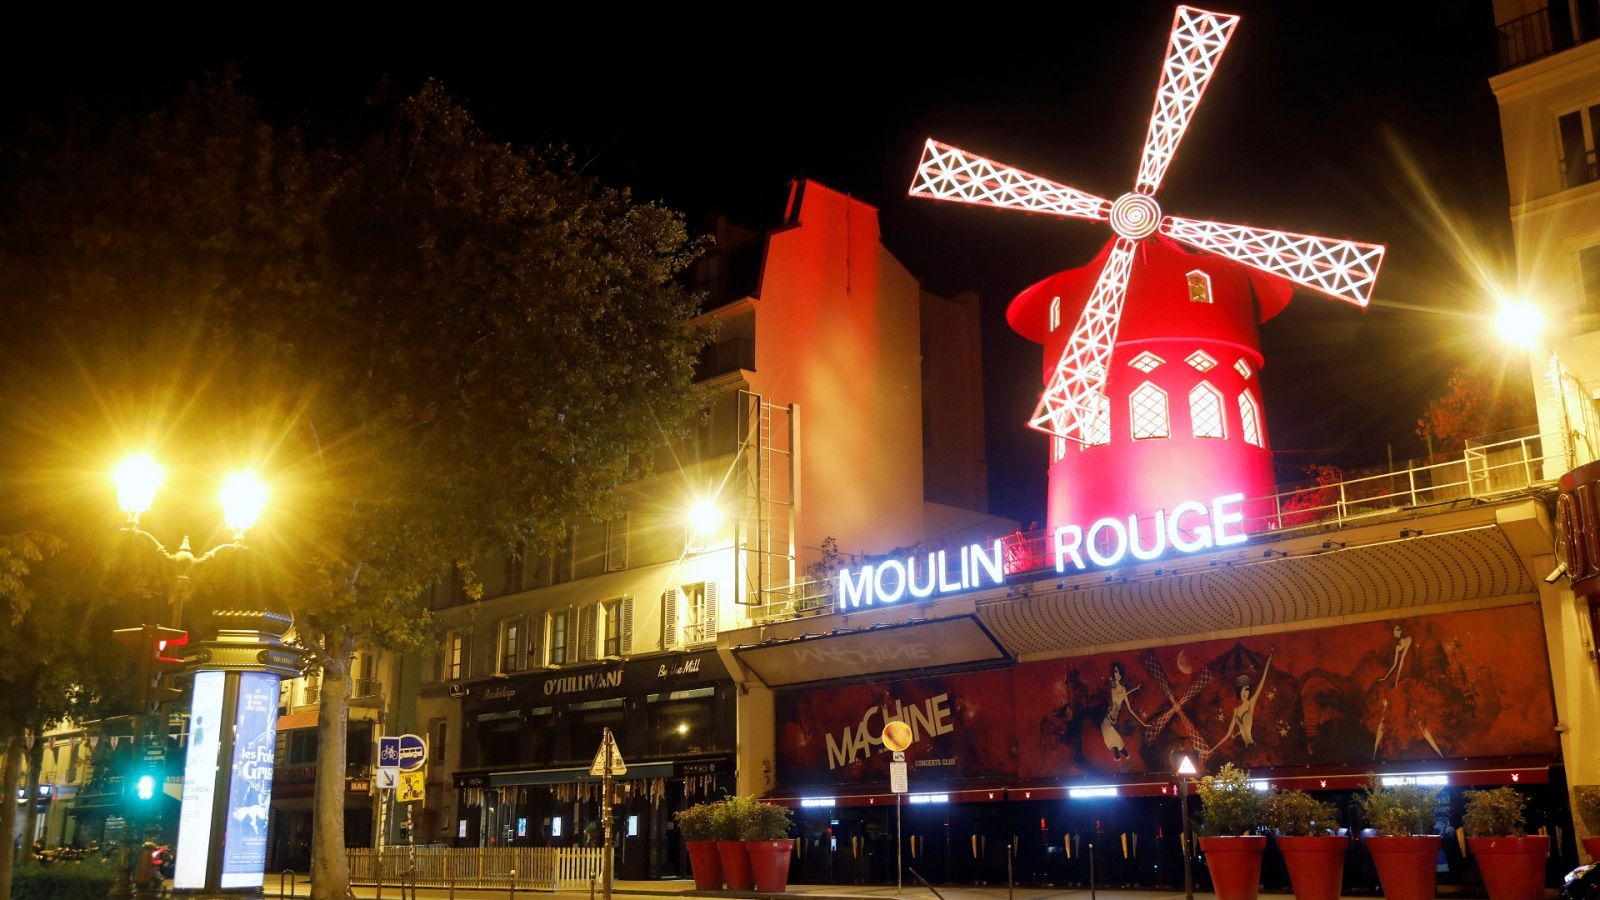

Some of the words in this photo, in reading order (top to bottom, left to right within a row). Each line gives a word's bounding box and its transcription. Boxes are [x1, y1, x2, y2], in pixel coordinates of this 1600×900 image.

[838, 538, 1004, 610] MOULIN
[1055, 493, 1248, 573] ROUGE
[682, 658, 701, 675] Mill
[543, 670, 624, 696] O'SULLIVANS
[825, 692, 954, 770] MACHINE
[241, 747, 256, 759] les
[915, 759, 941, 767] CONCERTS
[942, 758, 956, 766] CLUB
[351, 783, 367, 791] BAR
